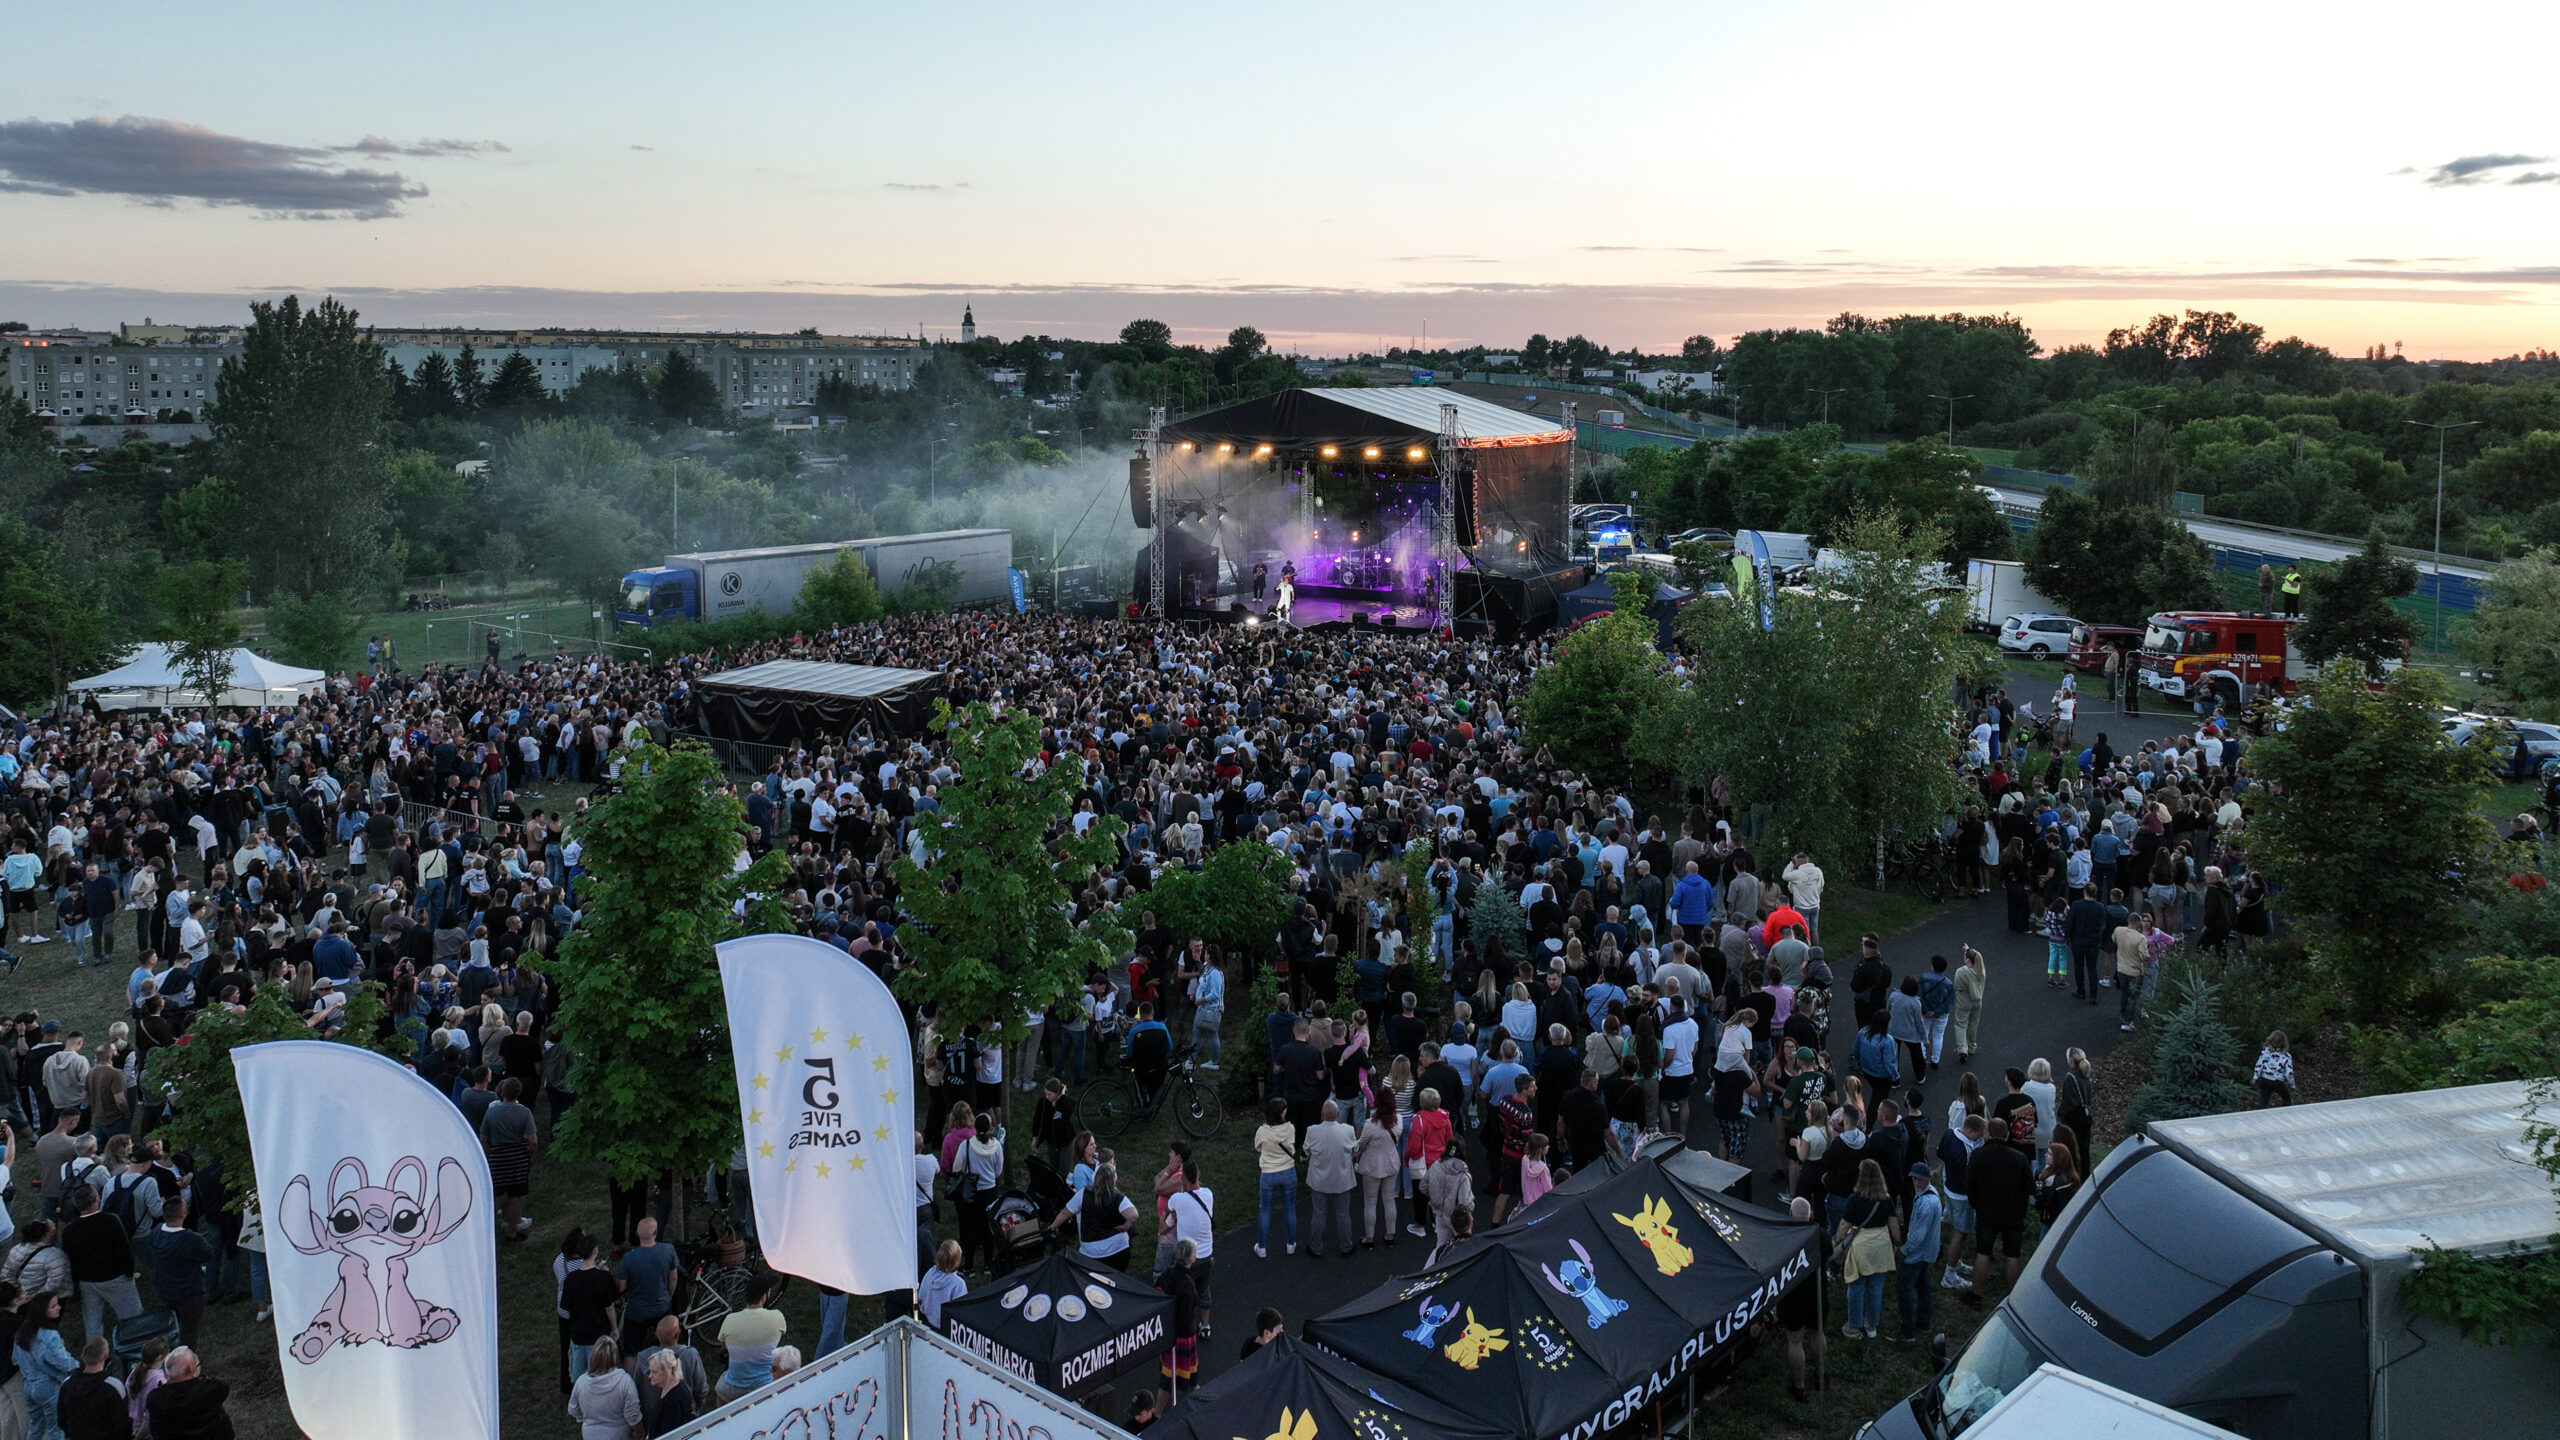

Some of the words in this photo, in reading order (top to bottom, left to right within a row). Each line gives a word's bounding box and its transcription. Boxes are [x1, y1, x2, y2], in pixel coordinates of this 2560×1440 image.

[718, 600, 745, 609] KUJAWA
[1680, 1247, 1811, 1372] PLUSZAKA
[2070, 1300, 2098, 1328] Lamico
[1530, 1326, 1551, 1348] 5
[1543, 1342, 1558, 1355] FIVE
[950, 1318, 1036, 1385] ROZMIENIARKA
[1062, 1315, 1163, 1389] ROZMIENIARKA
[1544, 1344, 1566, 1363] GAMES
